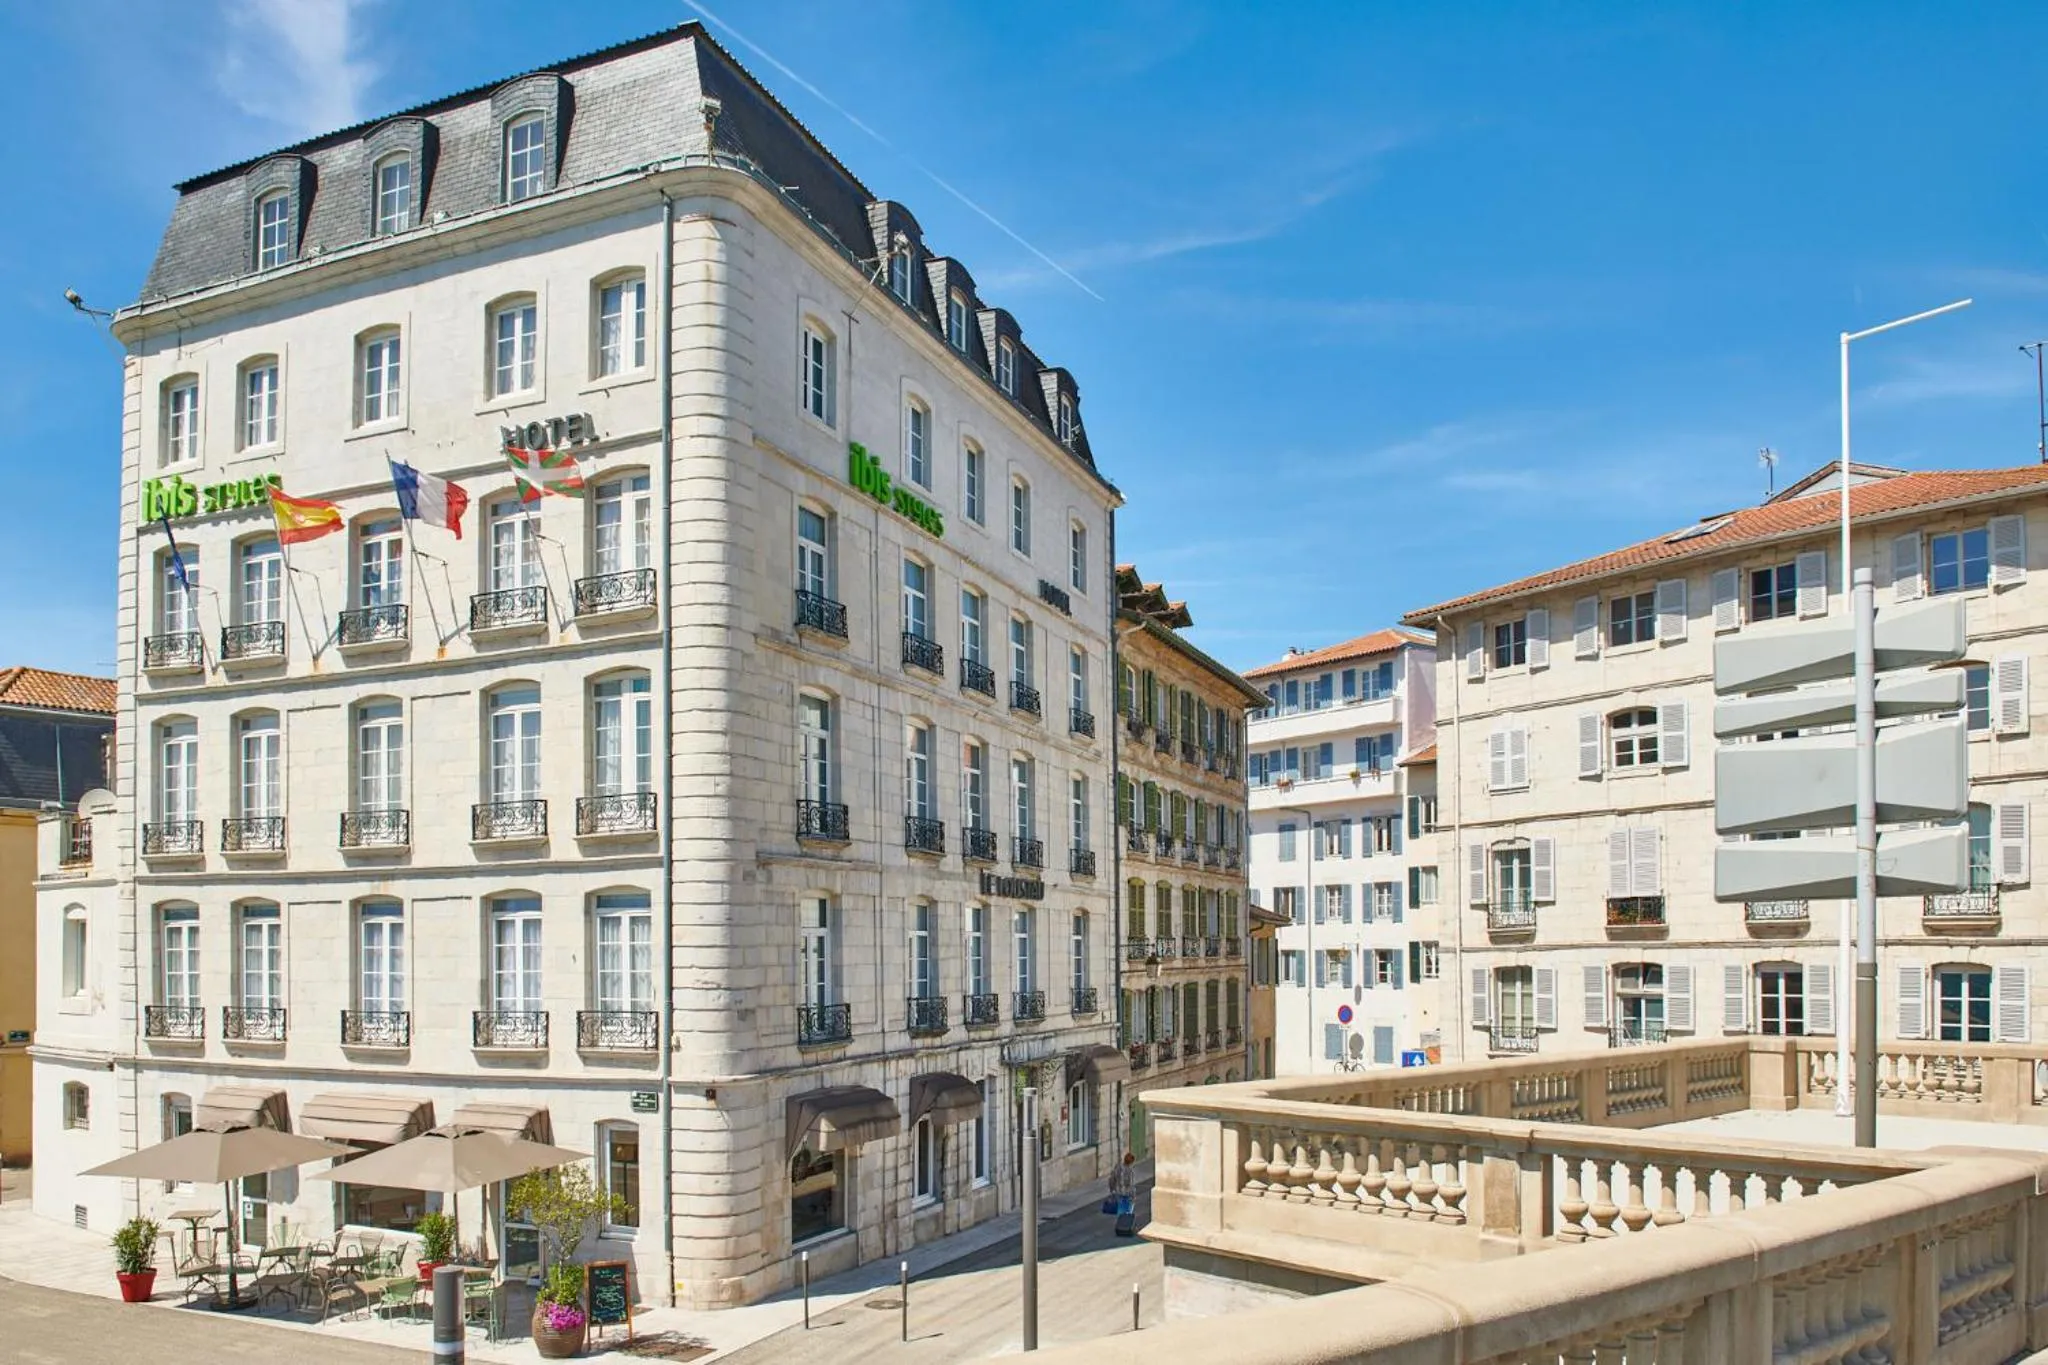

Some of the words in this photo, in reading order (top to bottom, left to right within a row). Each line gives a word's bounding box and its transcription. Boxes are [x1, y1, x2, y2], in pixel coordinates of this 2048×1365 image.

[500, 412, 600, 451] HOTEL
[849, 442, 892, 504] ibis
[142, 474, 197, 521] ibis
